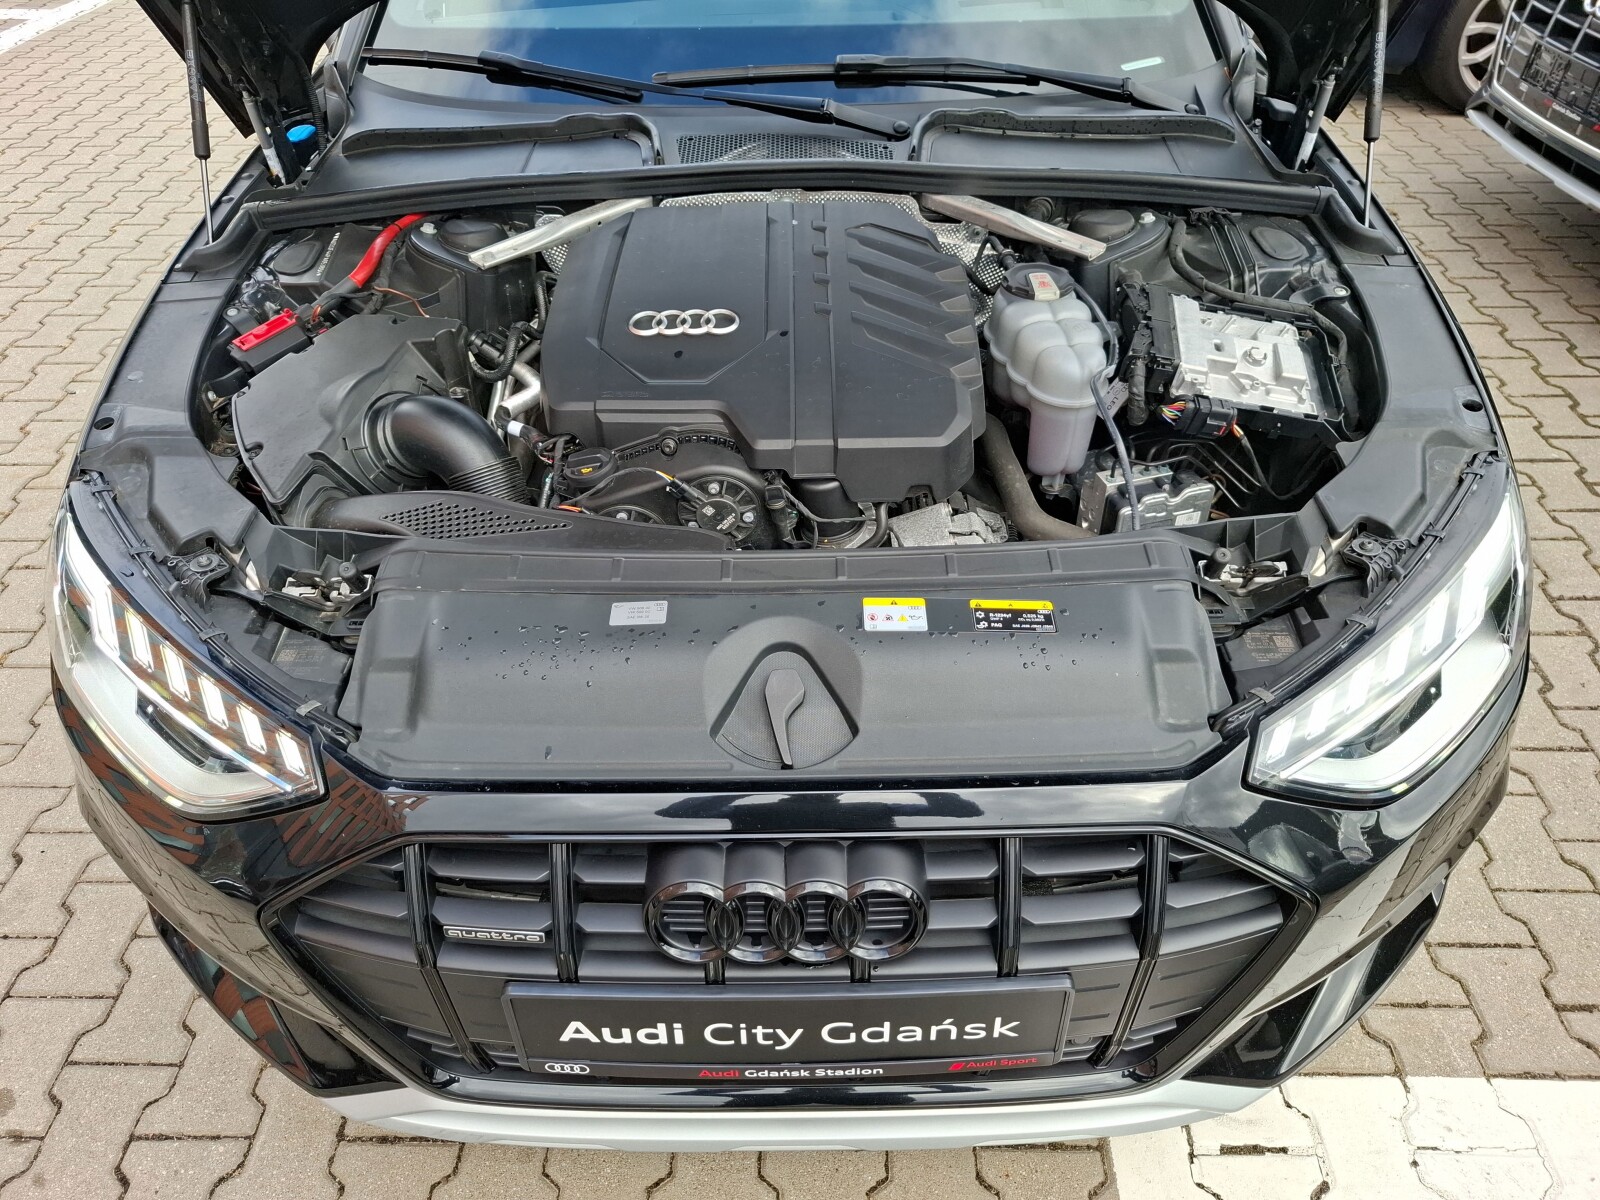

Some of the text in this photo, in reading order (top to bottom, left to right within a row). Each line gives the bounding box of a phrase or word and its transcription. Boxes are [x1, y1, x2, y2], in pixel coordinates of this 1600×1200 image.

[447, 929, 541, 942] quattro
[559, 1016, 1022, 1050] Audi City Gdańsk
[966, 1057, 1038, 1069] Audi Sport
[698, 1067, 884, 1078] Audi Gdańsk Stadion
